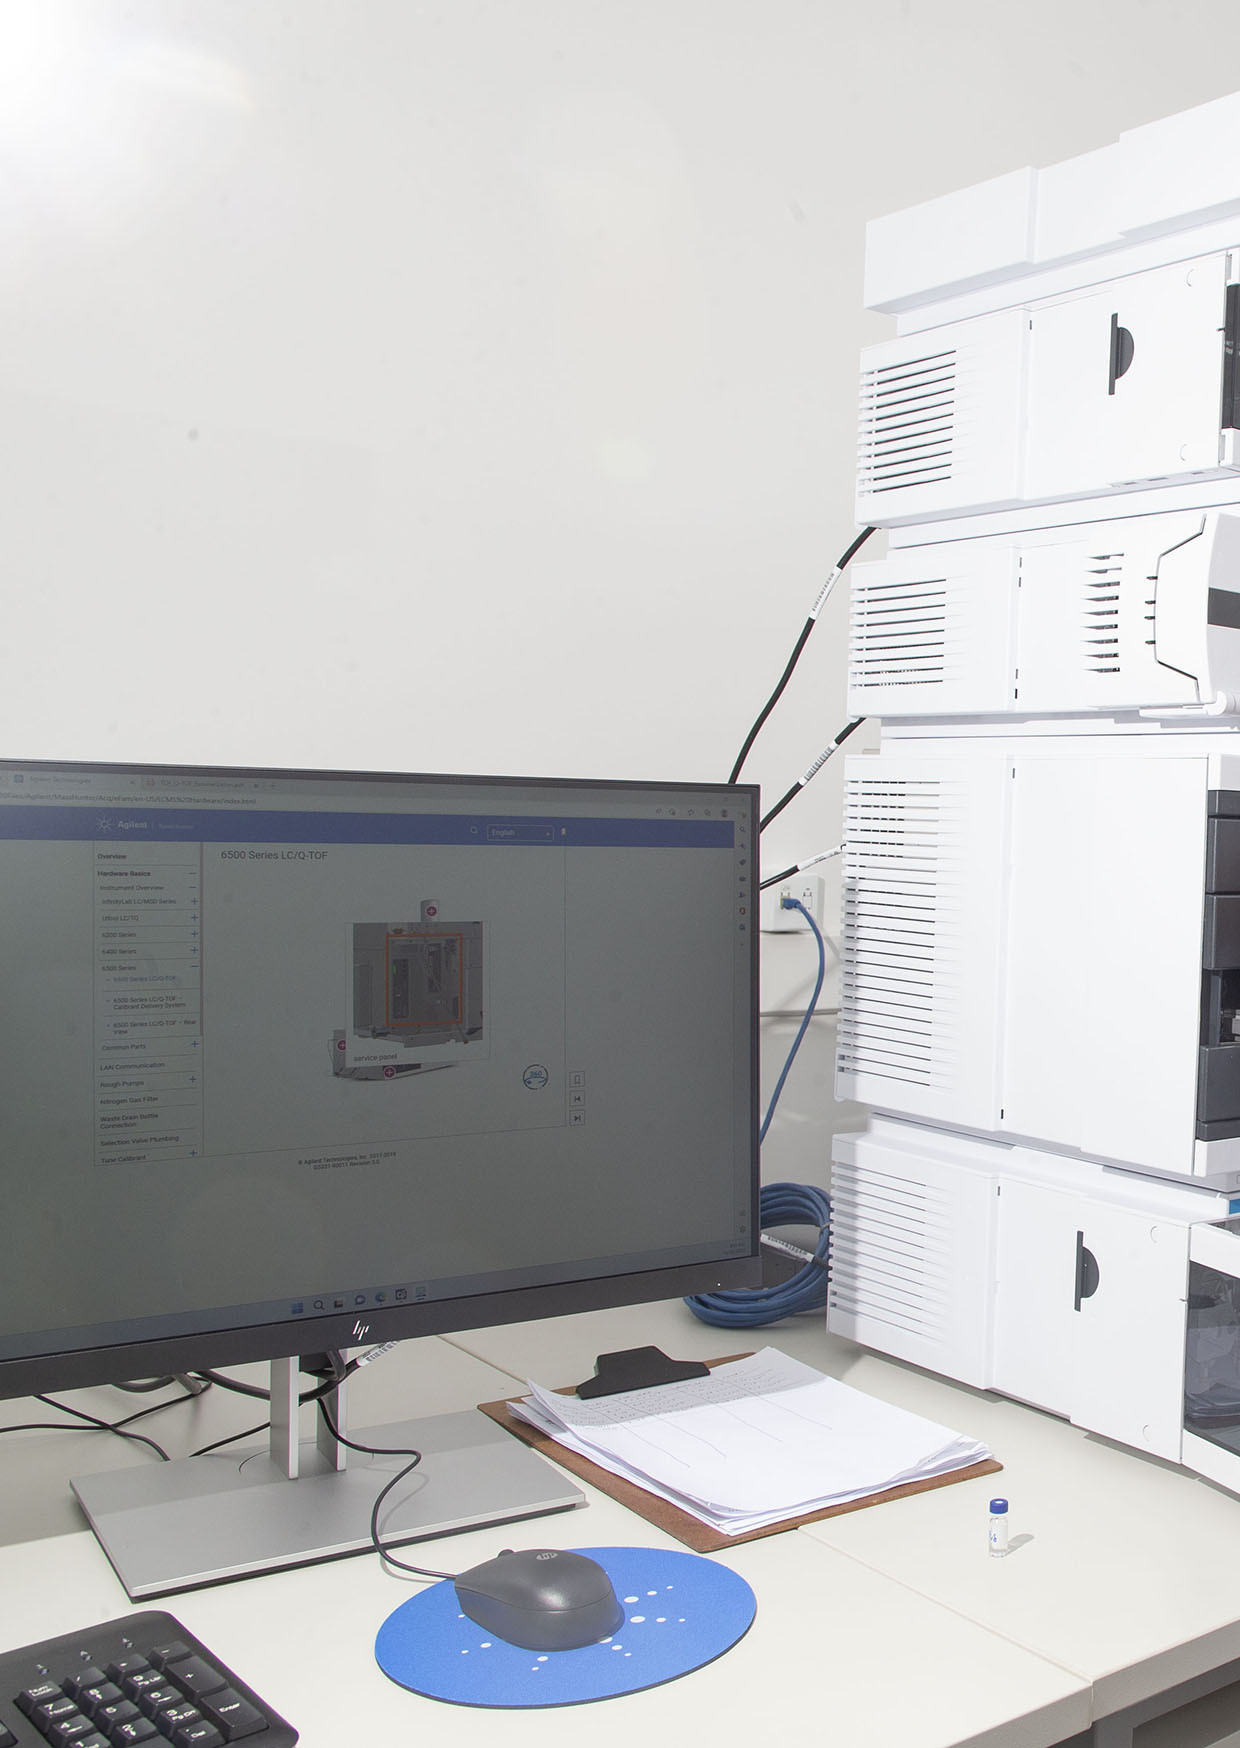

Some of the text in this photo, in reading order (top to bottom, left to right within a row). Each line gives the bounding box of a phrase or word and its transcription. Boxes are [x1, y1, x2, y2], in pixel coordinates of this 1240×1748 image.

[118, 820, 147, 831] Agilent
[221, 850, 328, 860] 6500 Series LC/Q-TOF
[379, 1053, 398, 1062] panel
[44, 1703, 54, 1711] 7
[49, 1704, 74, 1715] Home
[218, 1702, 240, 1713] Enter
[190, 1730, 207, 1739] Del
